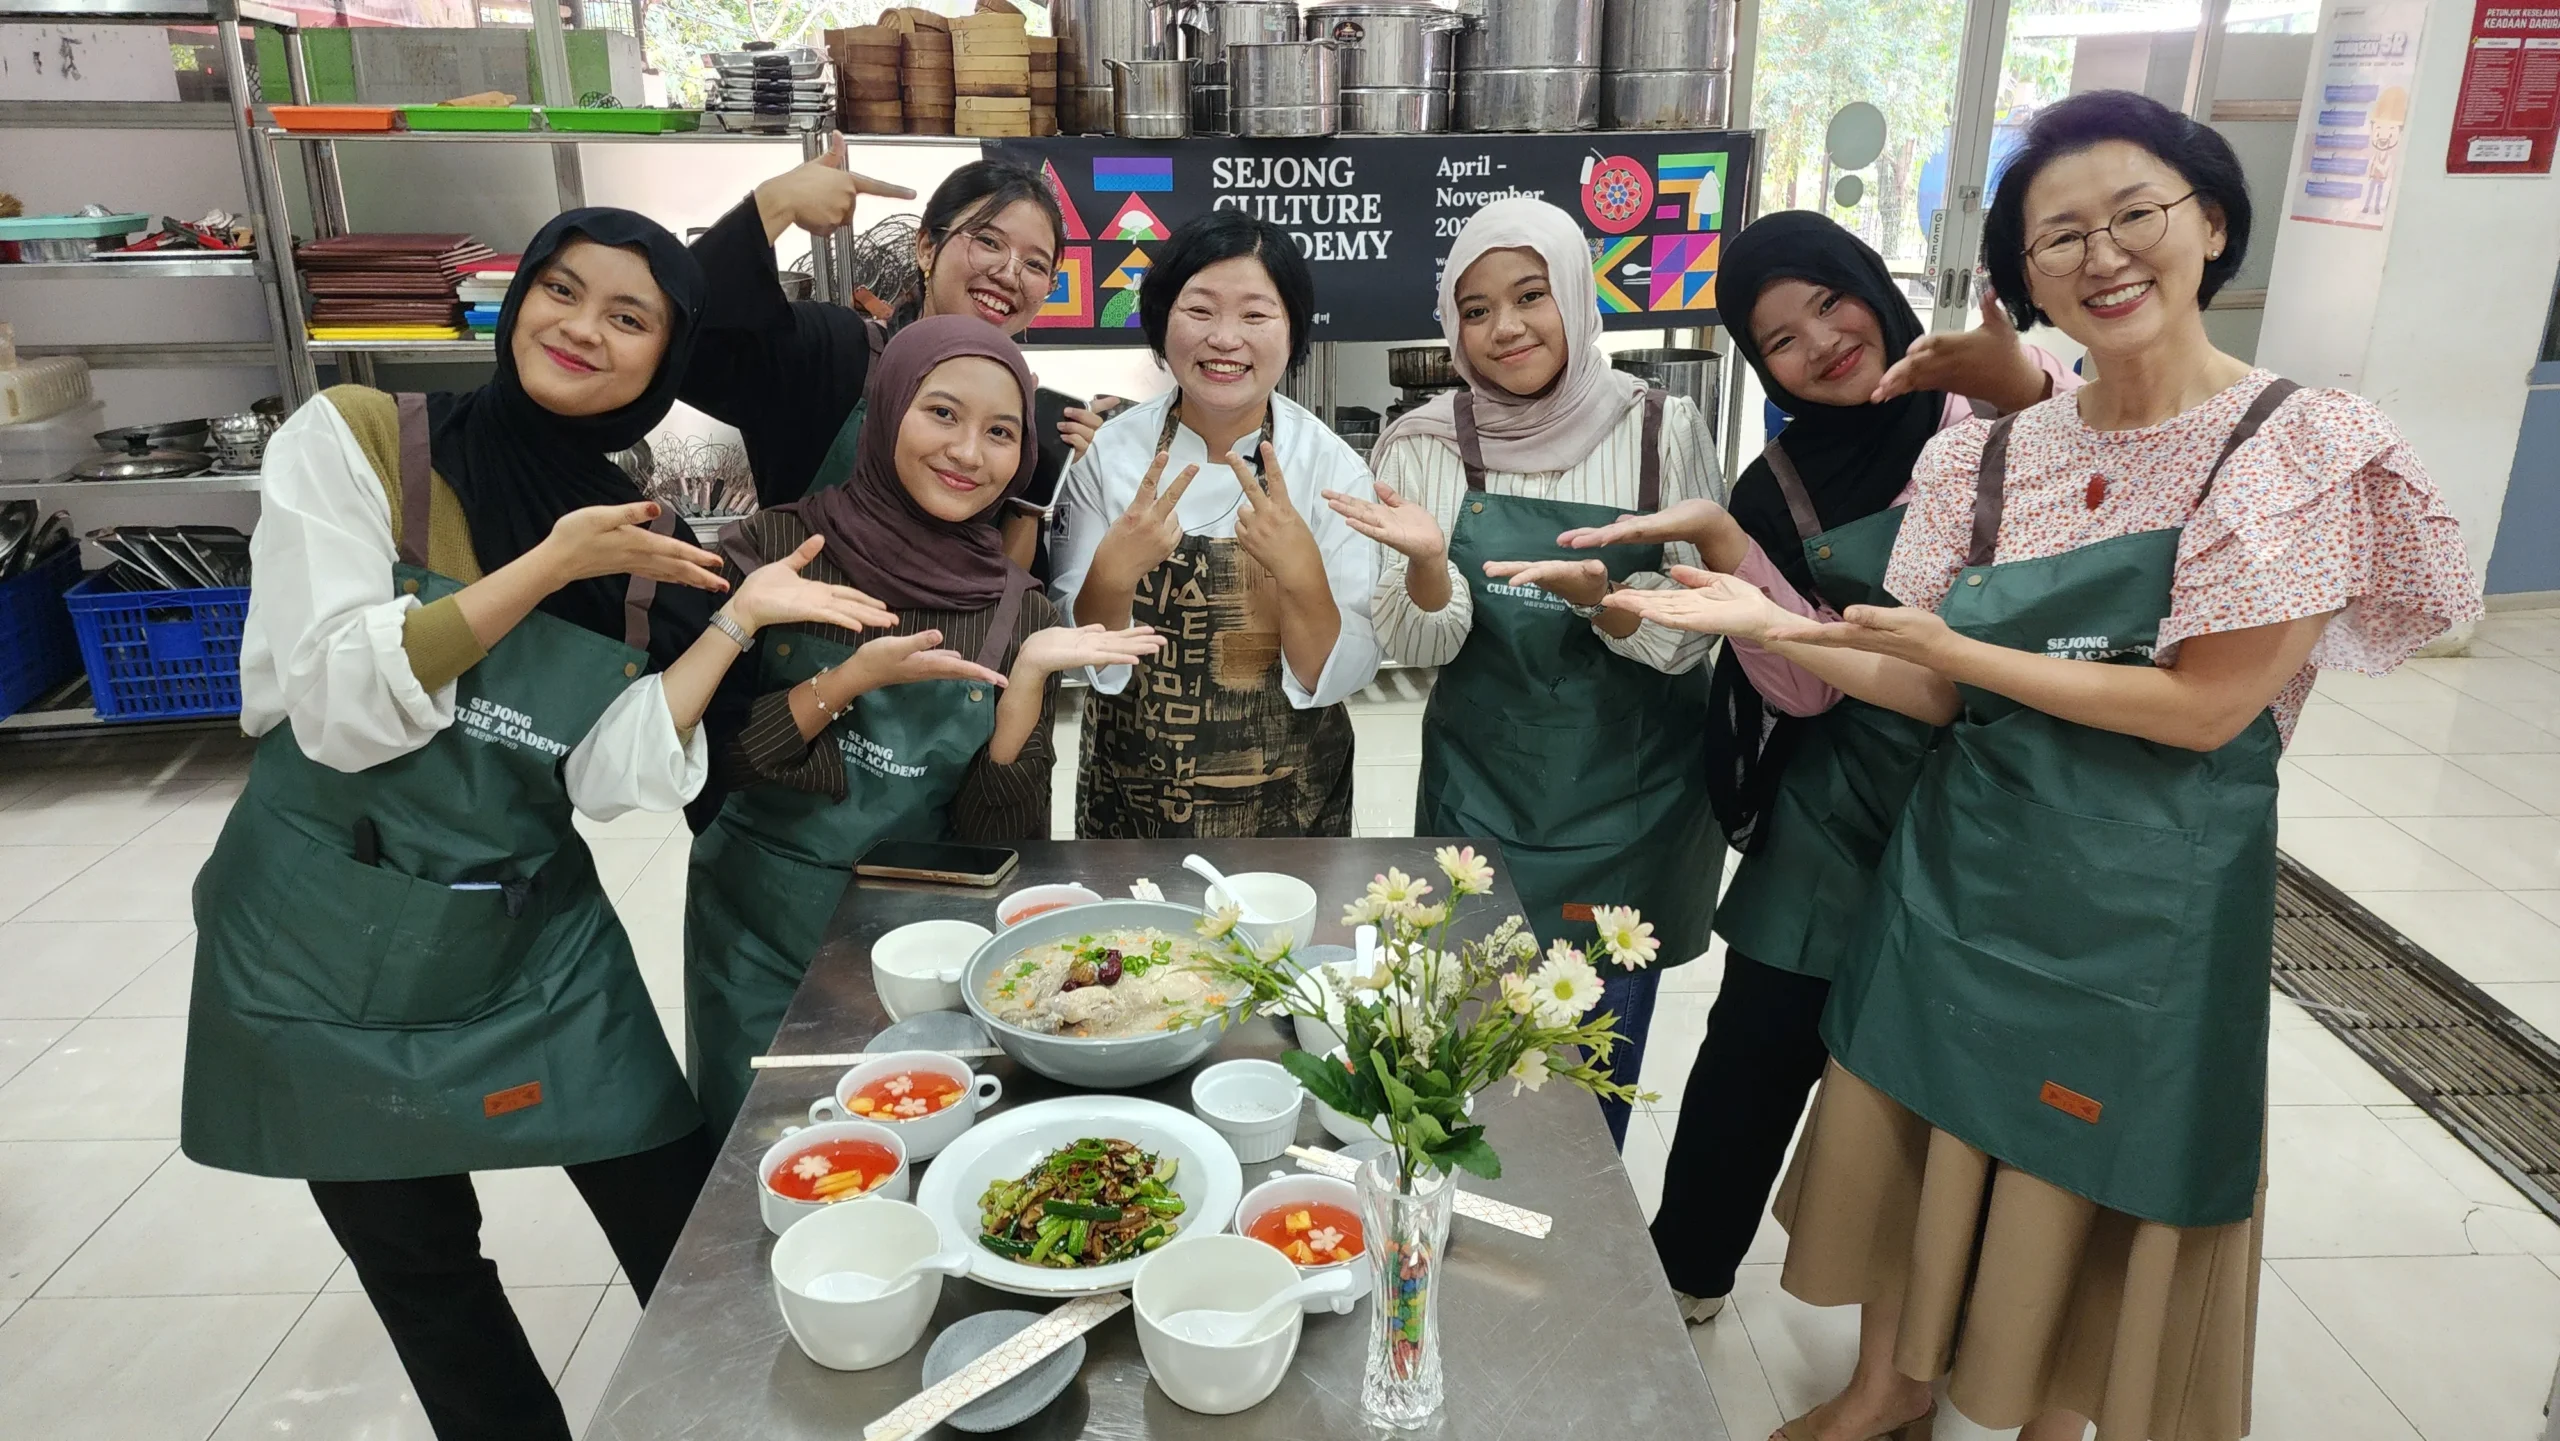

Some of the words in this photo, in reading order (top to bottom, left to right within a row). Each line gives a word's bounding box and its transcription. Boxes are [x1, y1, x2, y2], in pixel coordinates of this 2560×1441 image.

[2522, 8, 2560, 17] KESELAMA
[1212, 157, 1355, 188] SEJONG
[1436, 155, 1491, 183] April
[1289, 230, 1393, 261] DEMY
[1930, 213, 1943, 265] GESER
[1486, 582, 1542, 600] CULTURE
[2047, 636, 2109, 650] SEJONG
[469, 697, 533, 729] SEJONG
[493, 721, 571, 757] ACADEMY
[847, 730, 894, 761] SEJONG
[865, 753, 928, 778] ACADEMY
